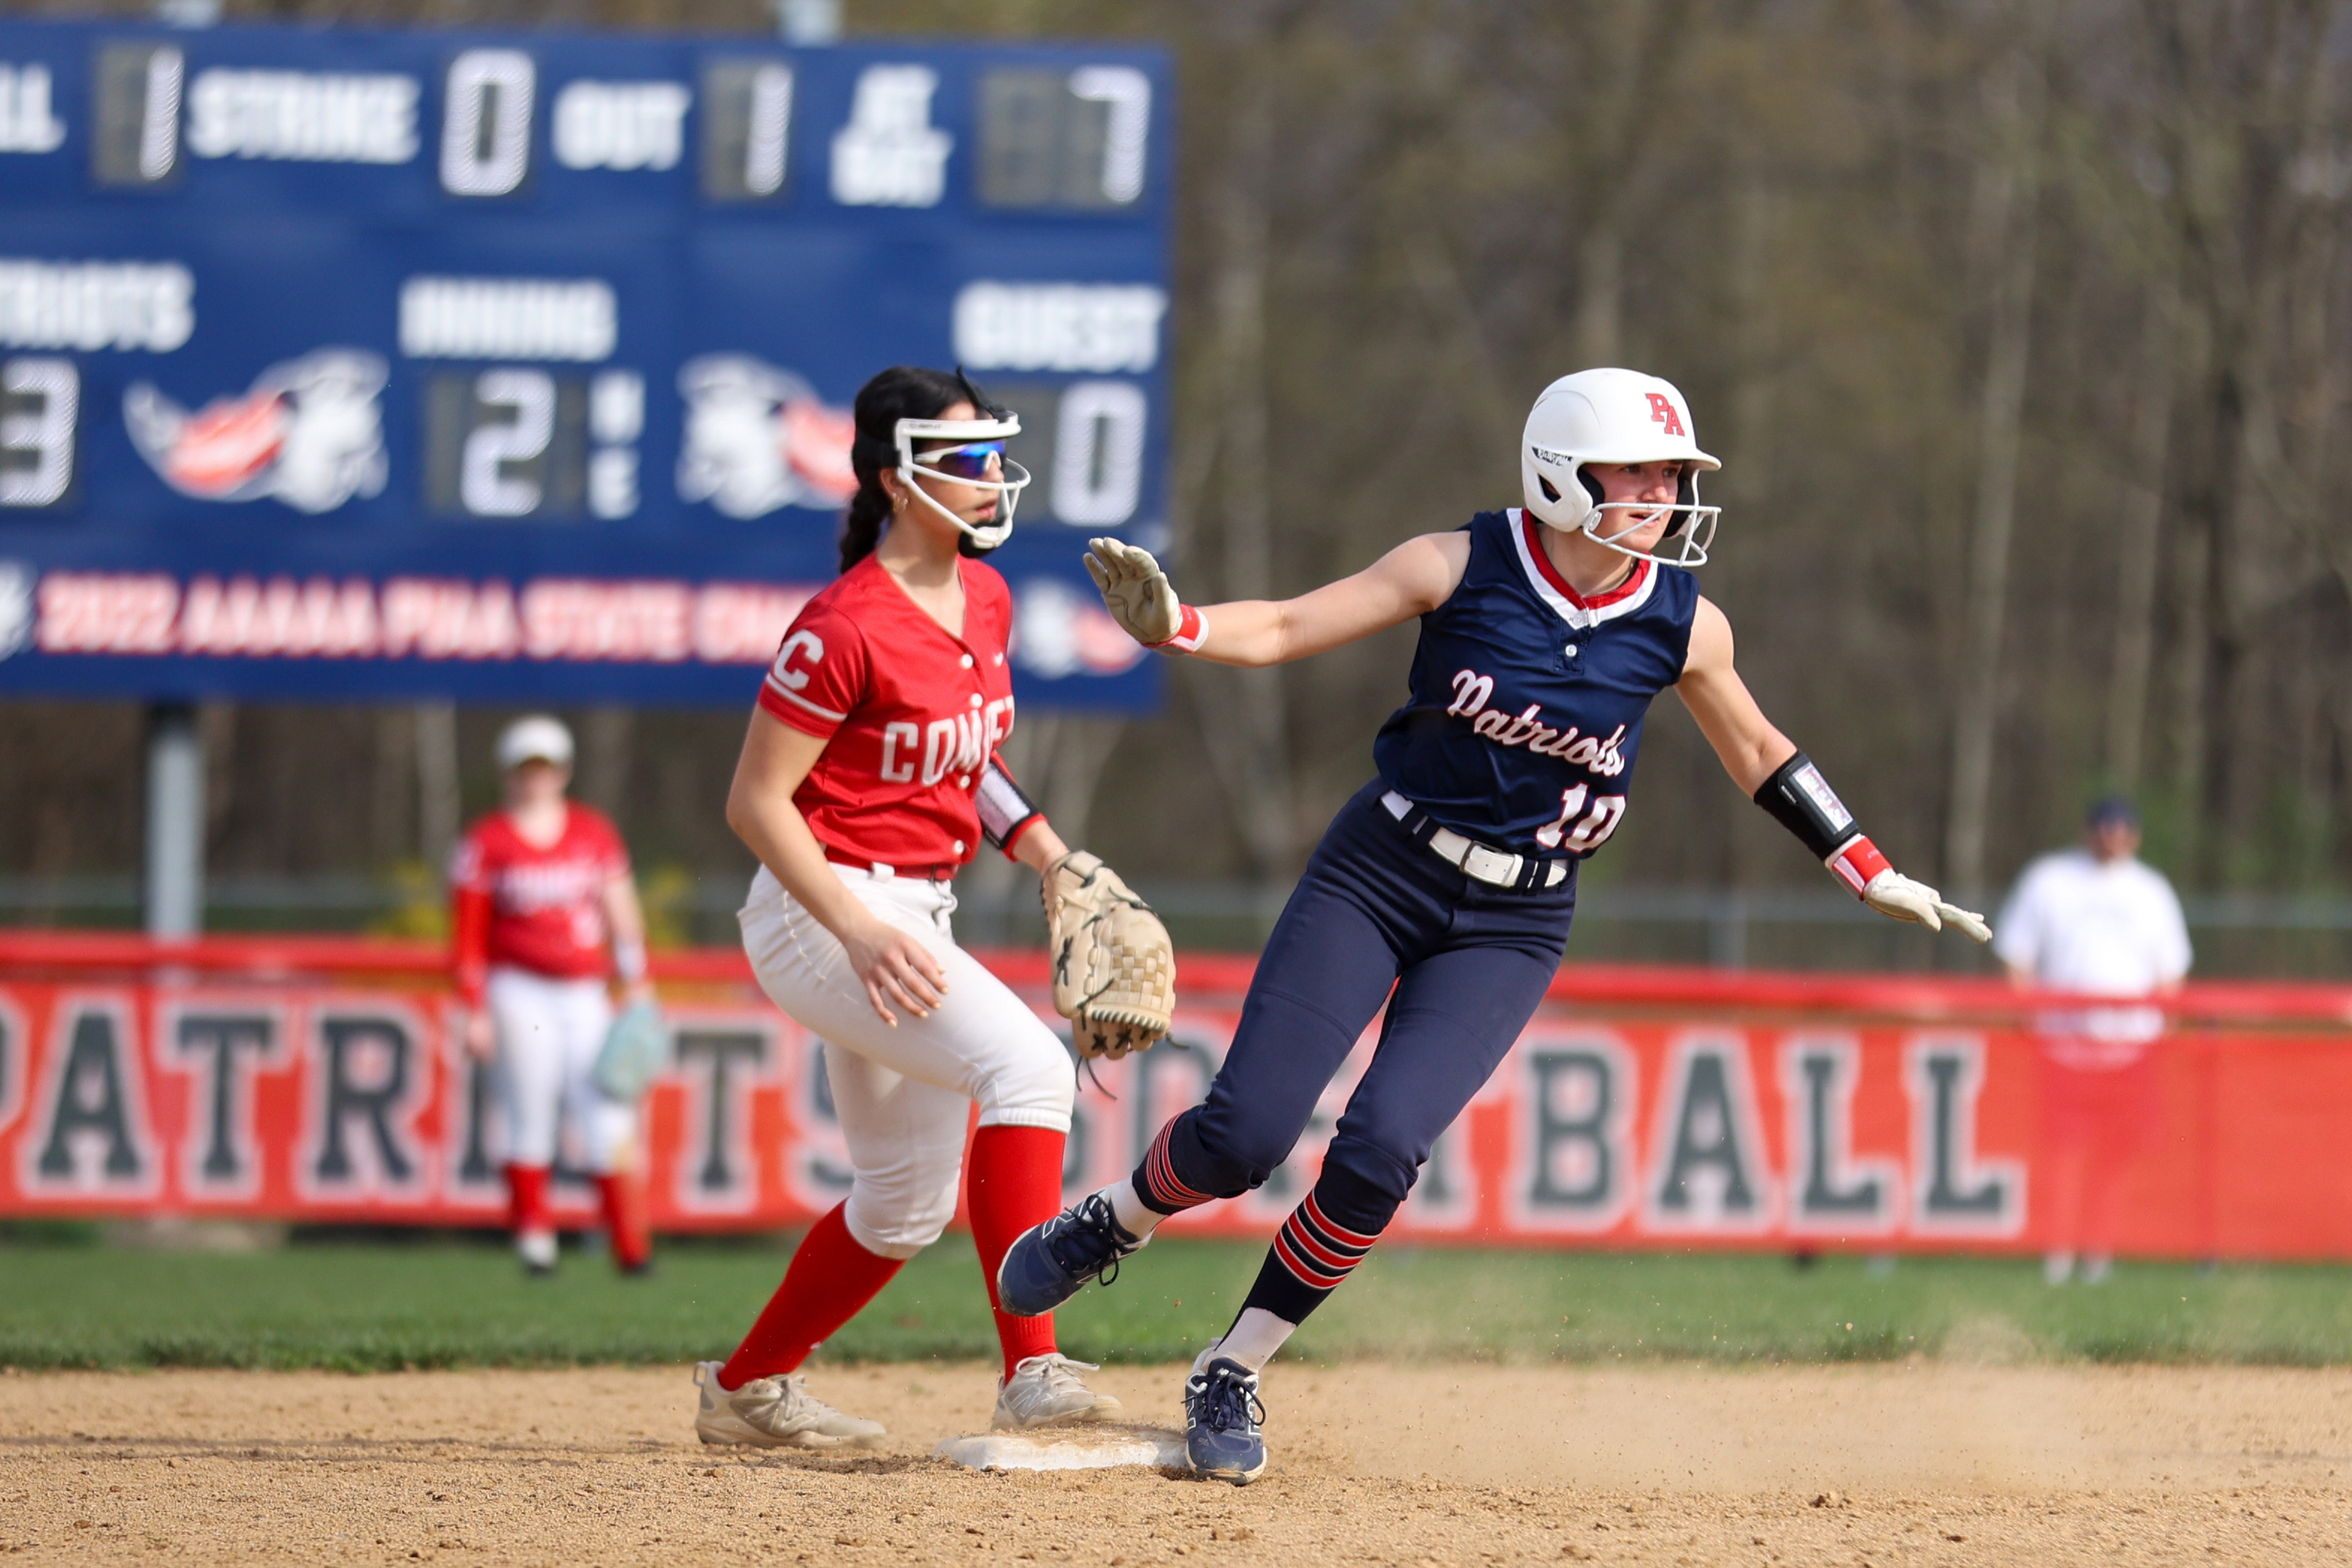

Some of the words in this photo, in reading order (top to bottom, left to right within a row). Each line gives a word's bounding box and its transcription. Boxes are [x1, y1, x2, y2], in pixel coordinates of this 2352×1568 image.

[140, 49, 183, 180] 1
[188, 69, 419, 162] STRIKE
[441, 49, 535, 195] 0
[553, 82, 689, 169] OUT
[746, 65, 793, 194] 1
[1070, 67, 1150, 202] 7
[0, 260, 194, 351] RIOTS
[400, 279, 616, 361] INNING
[953, 281, 1165, 372] GUEST
[0, 358, 79, 506] 3
[462, 370, 555, 516] 2
[1052, 382, 1146, 526] 0
[1644, 393, 1686, 437] PA
[38, 574, 177, 653] 2022
[383, 578, 518, 658] PIAA
[522, 579, 688, 661] STATE
[772, 629, 825, 691] C
[1447, 669, 1626, 776] Patriots
[1536, 782, 1626, 853] 10
